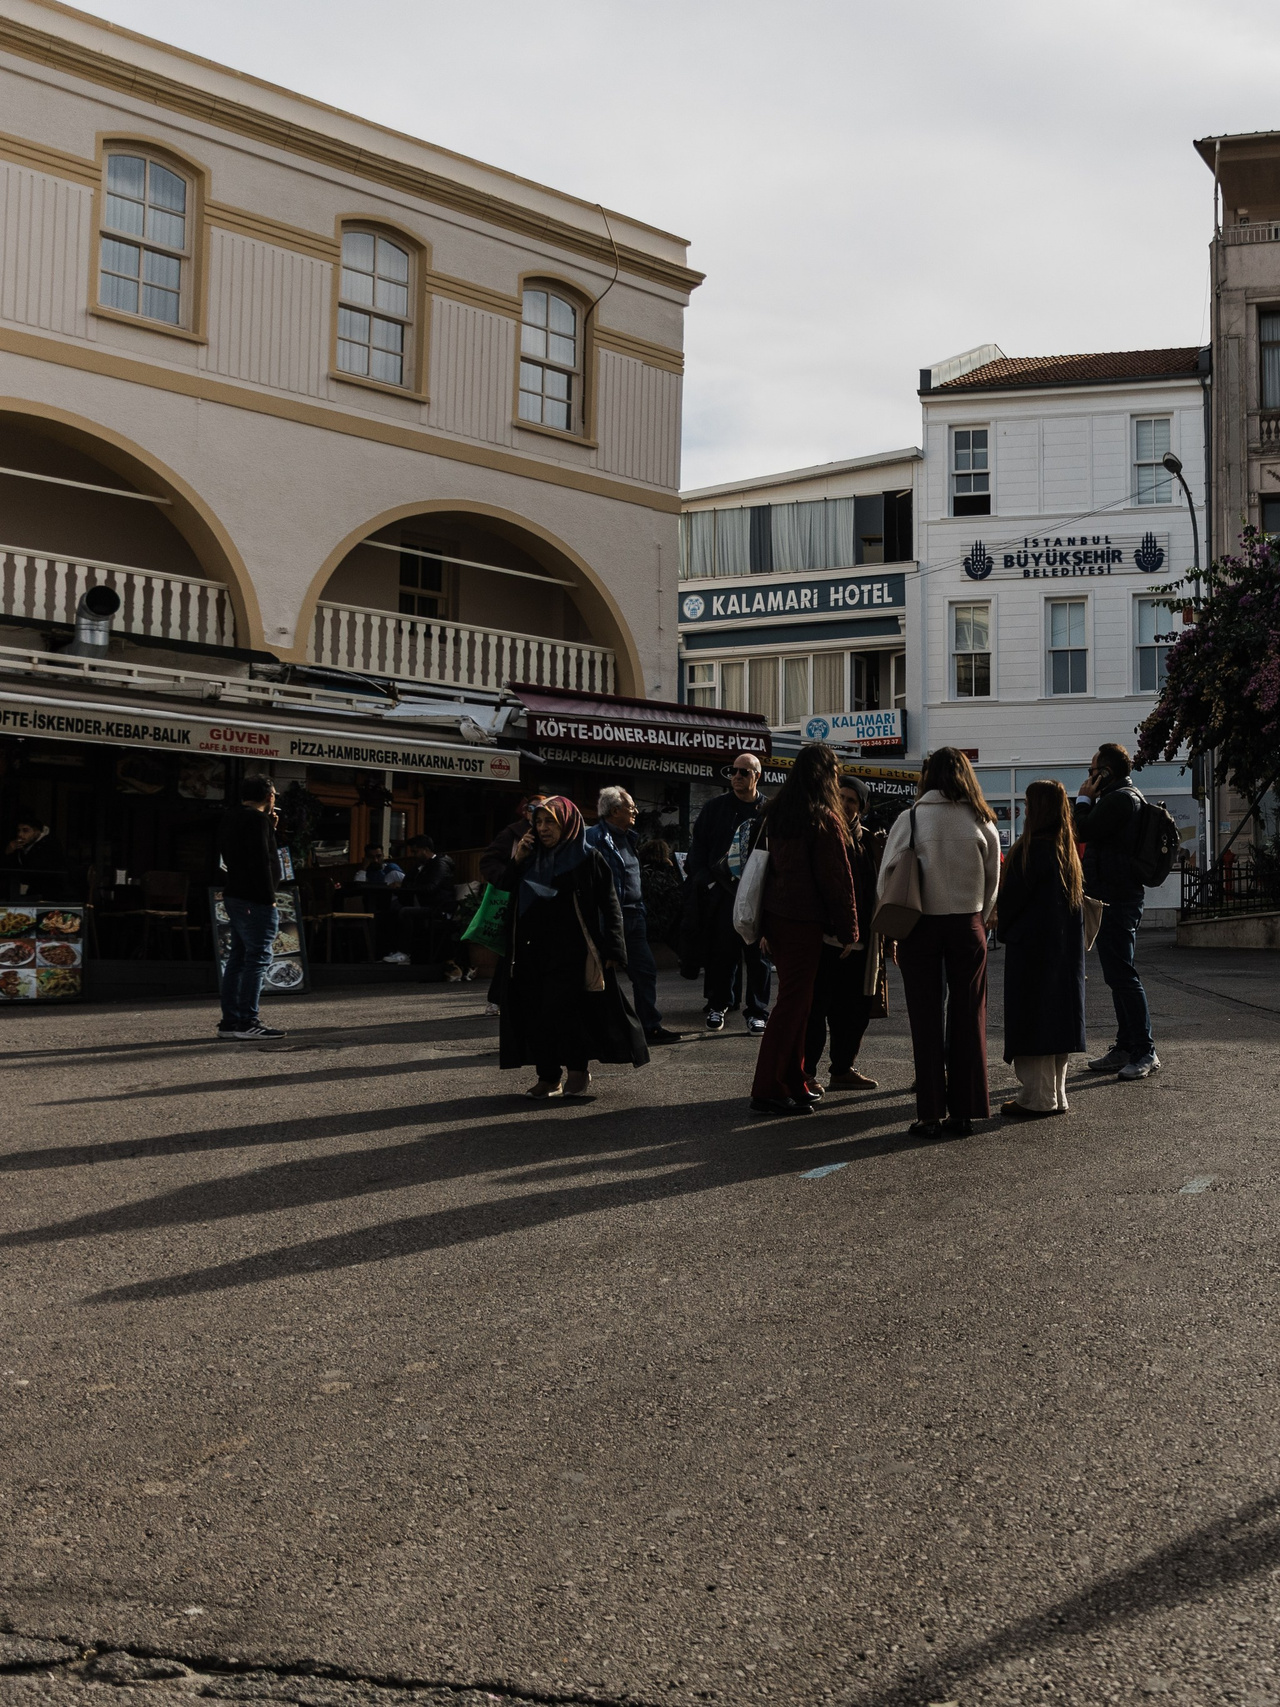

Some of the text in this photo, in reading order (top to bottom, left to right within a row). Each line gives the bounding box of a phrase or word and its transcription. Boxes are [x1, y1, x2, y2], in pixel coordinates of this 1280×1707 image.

[1024, 535, 1111, 548] İSTANBUL
[1003, 547, 1122, 569] BÜYÜKŞEHİR
[1023, 564, 1111, 578] BELEDİYESİ
[830, 583, 893, 607] HOTEL
[0, 710, 191, 744] FTE-İSKENDER-KEBAP-BALIK
[209, 727, 270, 746] GÜVEN
[535, 718, 767, 753] KÖFTE-DÖNER-BALIK-PİDE-PİZZA
[857, 724, 895, 738] HOTEL
[199, 742, 279, 757] CAFE & RESTAURANT
[290, 738, 485, 773] PİZZA-HAMBURGER-MAKARNA-TOST
[538, 746, 714, 777] KEBAP-BALIK-DÖNER-İSKENDER
[842, 764, 915, 779] Cafe Latte
